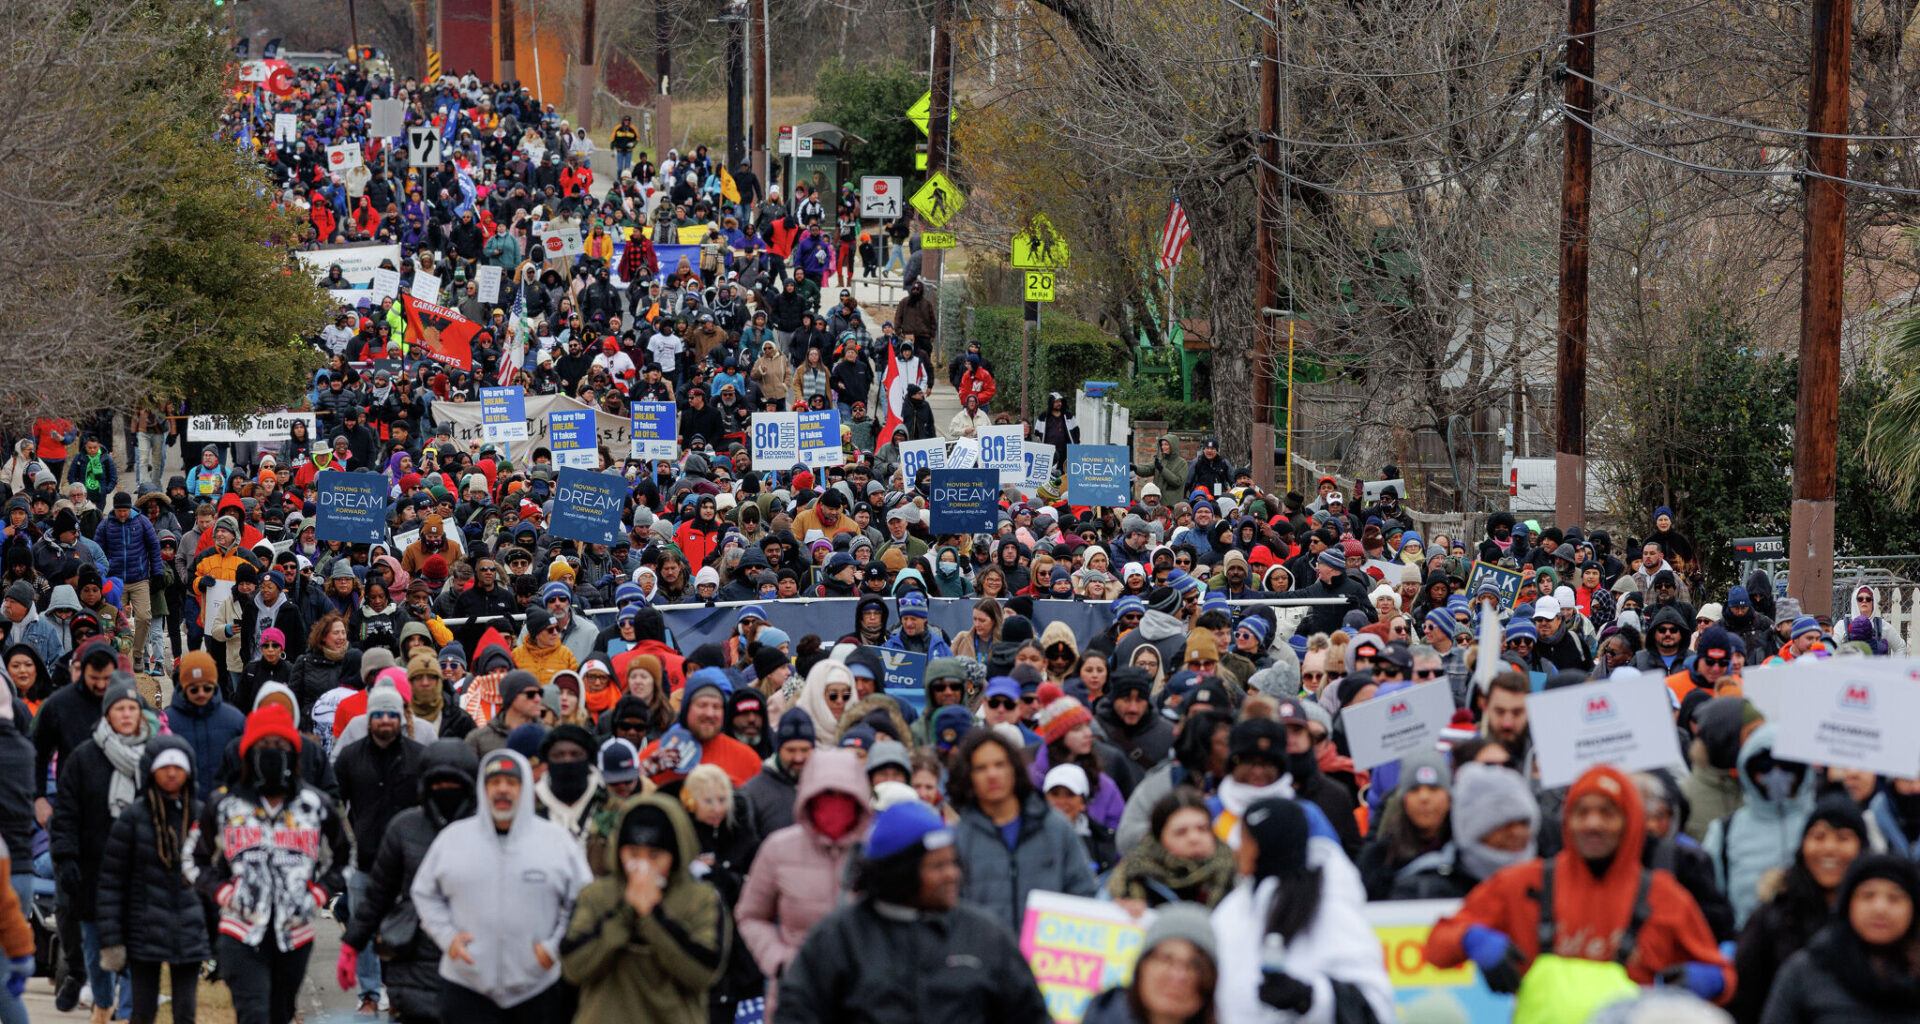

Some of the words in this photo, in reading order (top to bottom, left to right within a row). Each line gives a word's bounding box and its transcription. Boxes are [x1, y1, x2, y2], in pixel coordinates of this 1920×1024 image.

[926, 236, 952, 244] AHEAD
[1029, 276, 1051, 289] 20
[412, 300, 466, 323] CARNALISMO
[193, 420, 211, 430] San
[257, 419, 274, 430] Zen
[756, 423, 778, 448] 80
[781, 422, 795, 448] YEARS
[981, 436, 1005, 462] 80
[1006, 435, 1022, 461] YEARS
[904, 450, 928, 477] 80
[1032, 454, 1050, 480] YEARS
[1071, 462, 1126, 476] DREAM
[574, 483, 597, 492] MOVING
[934, 488, 995, 501] DREAM
[321, 492, 383, 509] DREAM
[559, 488, 621, 511] DREAM
[573, 506, 602, 515] FORWARD
[1757, 542, 1782, 550] 2410
[224, 826, 262, 860] CASH
[274, 829, 319, 860] MONEY
[1038, 916, 1108, 951] ONE
[1030, 950, 1095, 983] DAY
